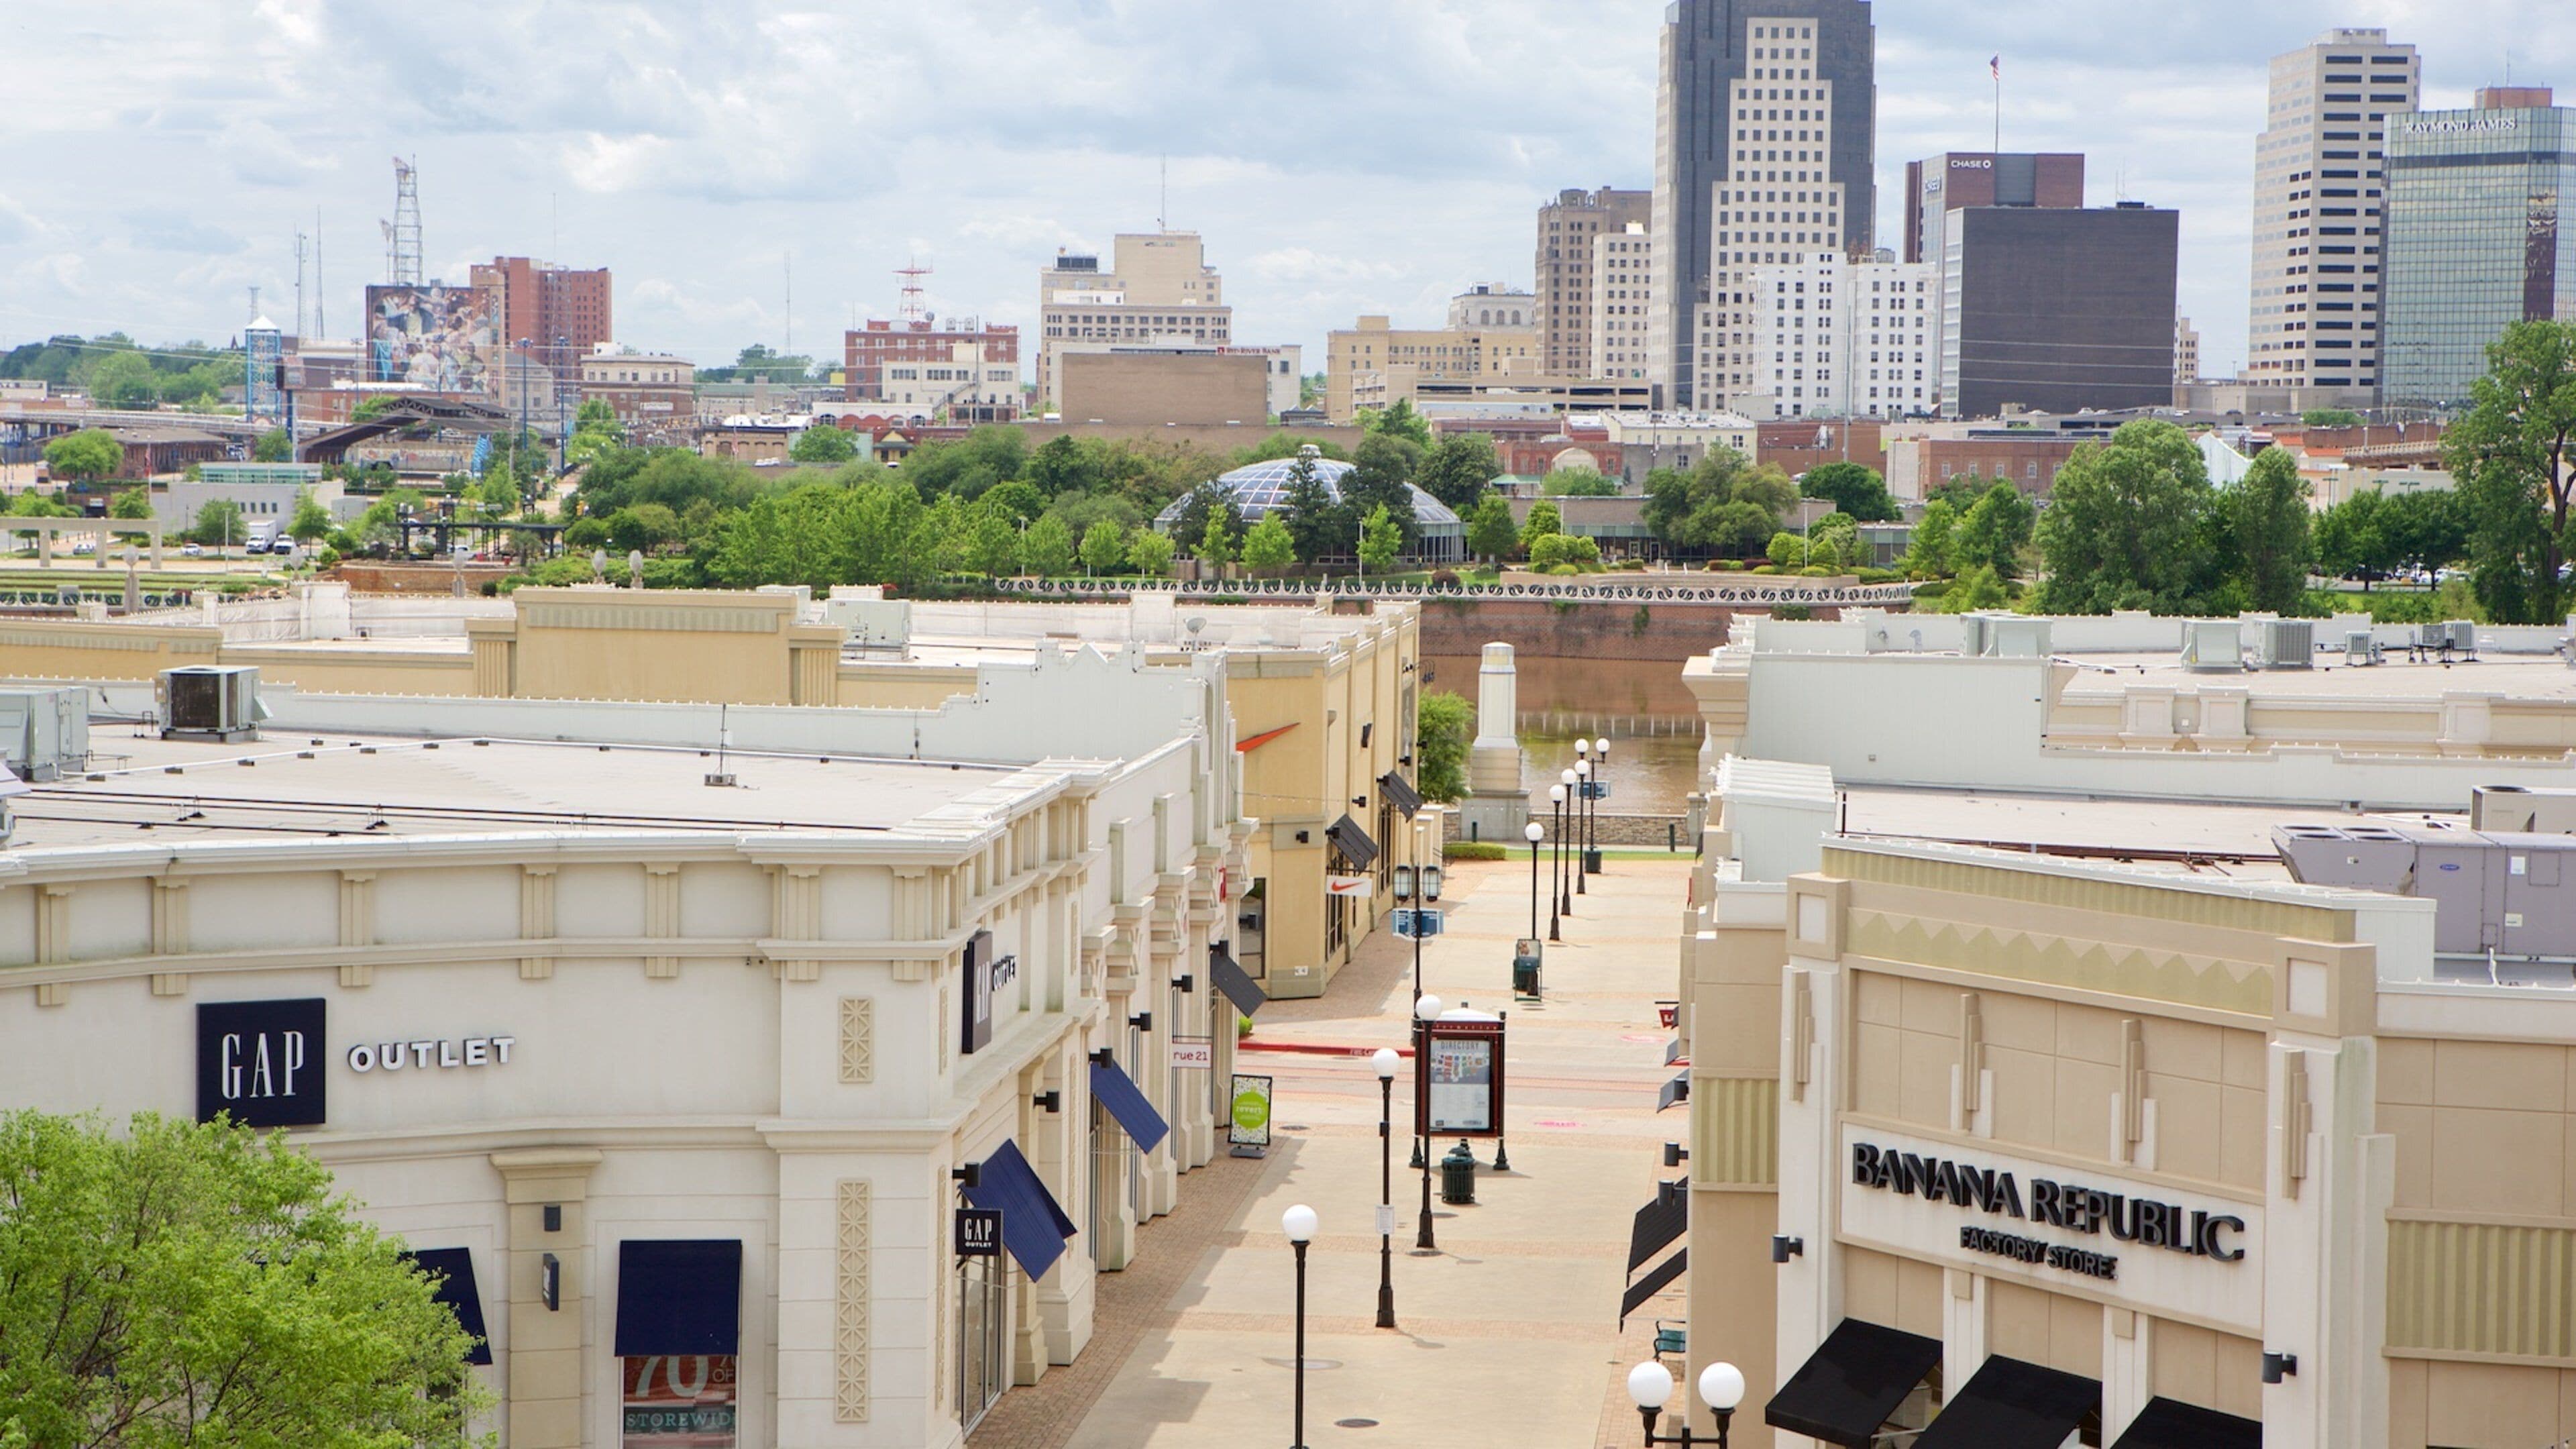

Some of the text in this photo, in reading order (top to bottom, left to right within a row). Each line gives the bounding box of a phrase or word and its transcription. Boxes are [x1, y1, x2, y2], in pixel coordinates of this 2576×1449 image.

[2406, 117, 2518, 133] RAYMOND JAMES
[1440, 1040, 1480, 1050] DIRECTORY
[222, 1031, 515, 1100] GAP OUTLET
[1852, 1142, 2245, 1262] BANANA REPUBLIC
[965, 1218, 992, 1240] GAP
[1960, 1226, 2118, 1280] FACTORY STORE
[635, 1356, 709, 1398] 70
[712, 1368, 735, 1383] OF
[627, 1411, 735, 1428] STOREWID
